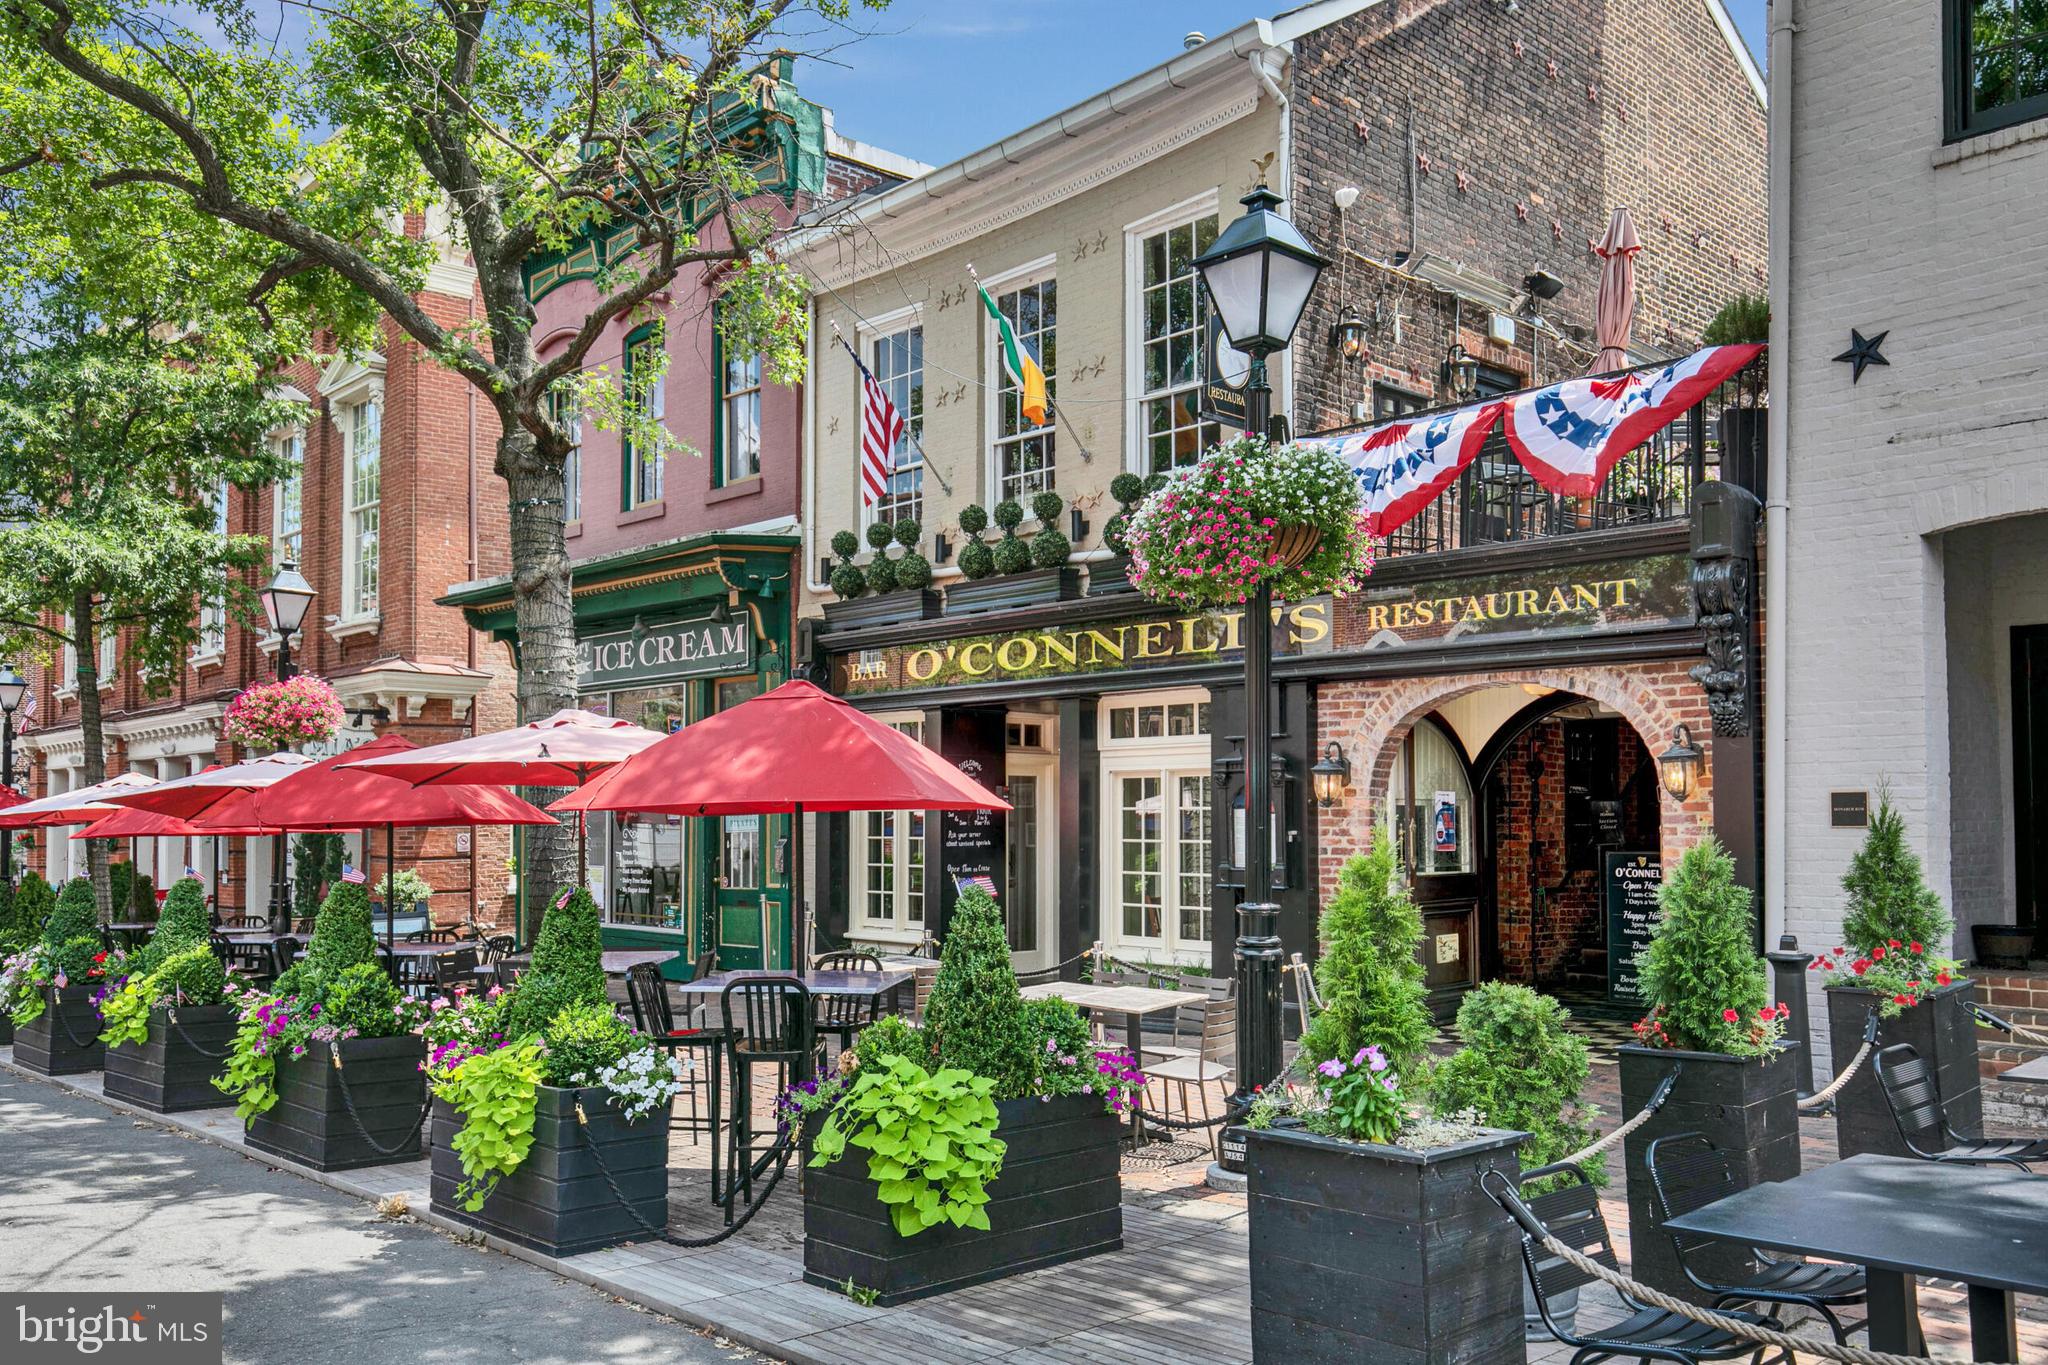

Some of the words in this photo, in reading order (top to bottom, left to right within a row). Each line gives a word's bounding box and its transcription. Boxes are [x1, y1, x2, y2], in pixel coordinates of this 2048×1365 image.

[1210, 386, 1246, 406] RESTAURA
[1367, 578, 1637, 630] RESTAURANT
[593, 639, 636, 672] ICE
[639, 624, 745, 667] CREAM
[850, 660, 888, 682] BAR
[946, 863, 960, 874] Open
[1614, 867, 1662, 878] O'CONNEL
[1622, 880, 1642, 891] Open
[1629, 898, 1643, 906] Days
[1622, 910, 1646, 921] Happy
